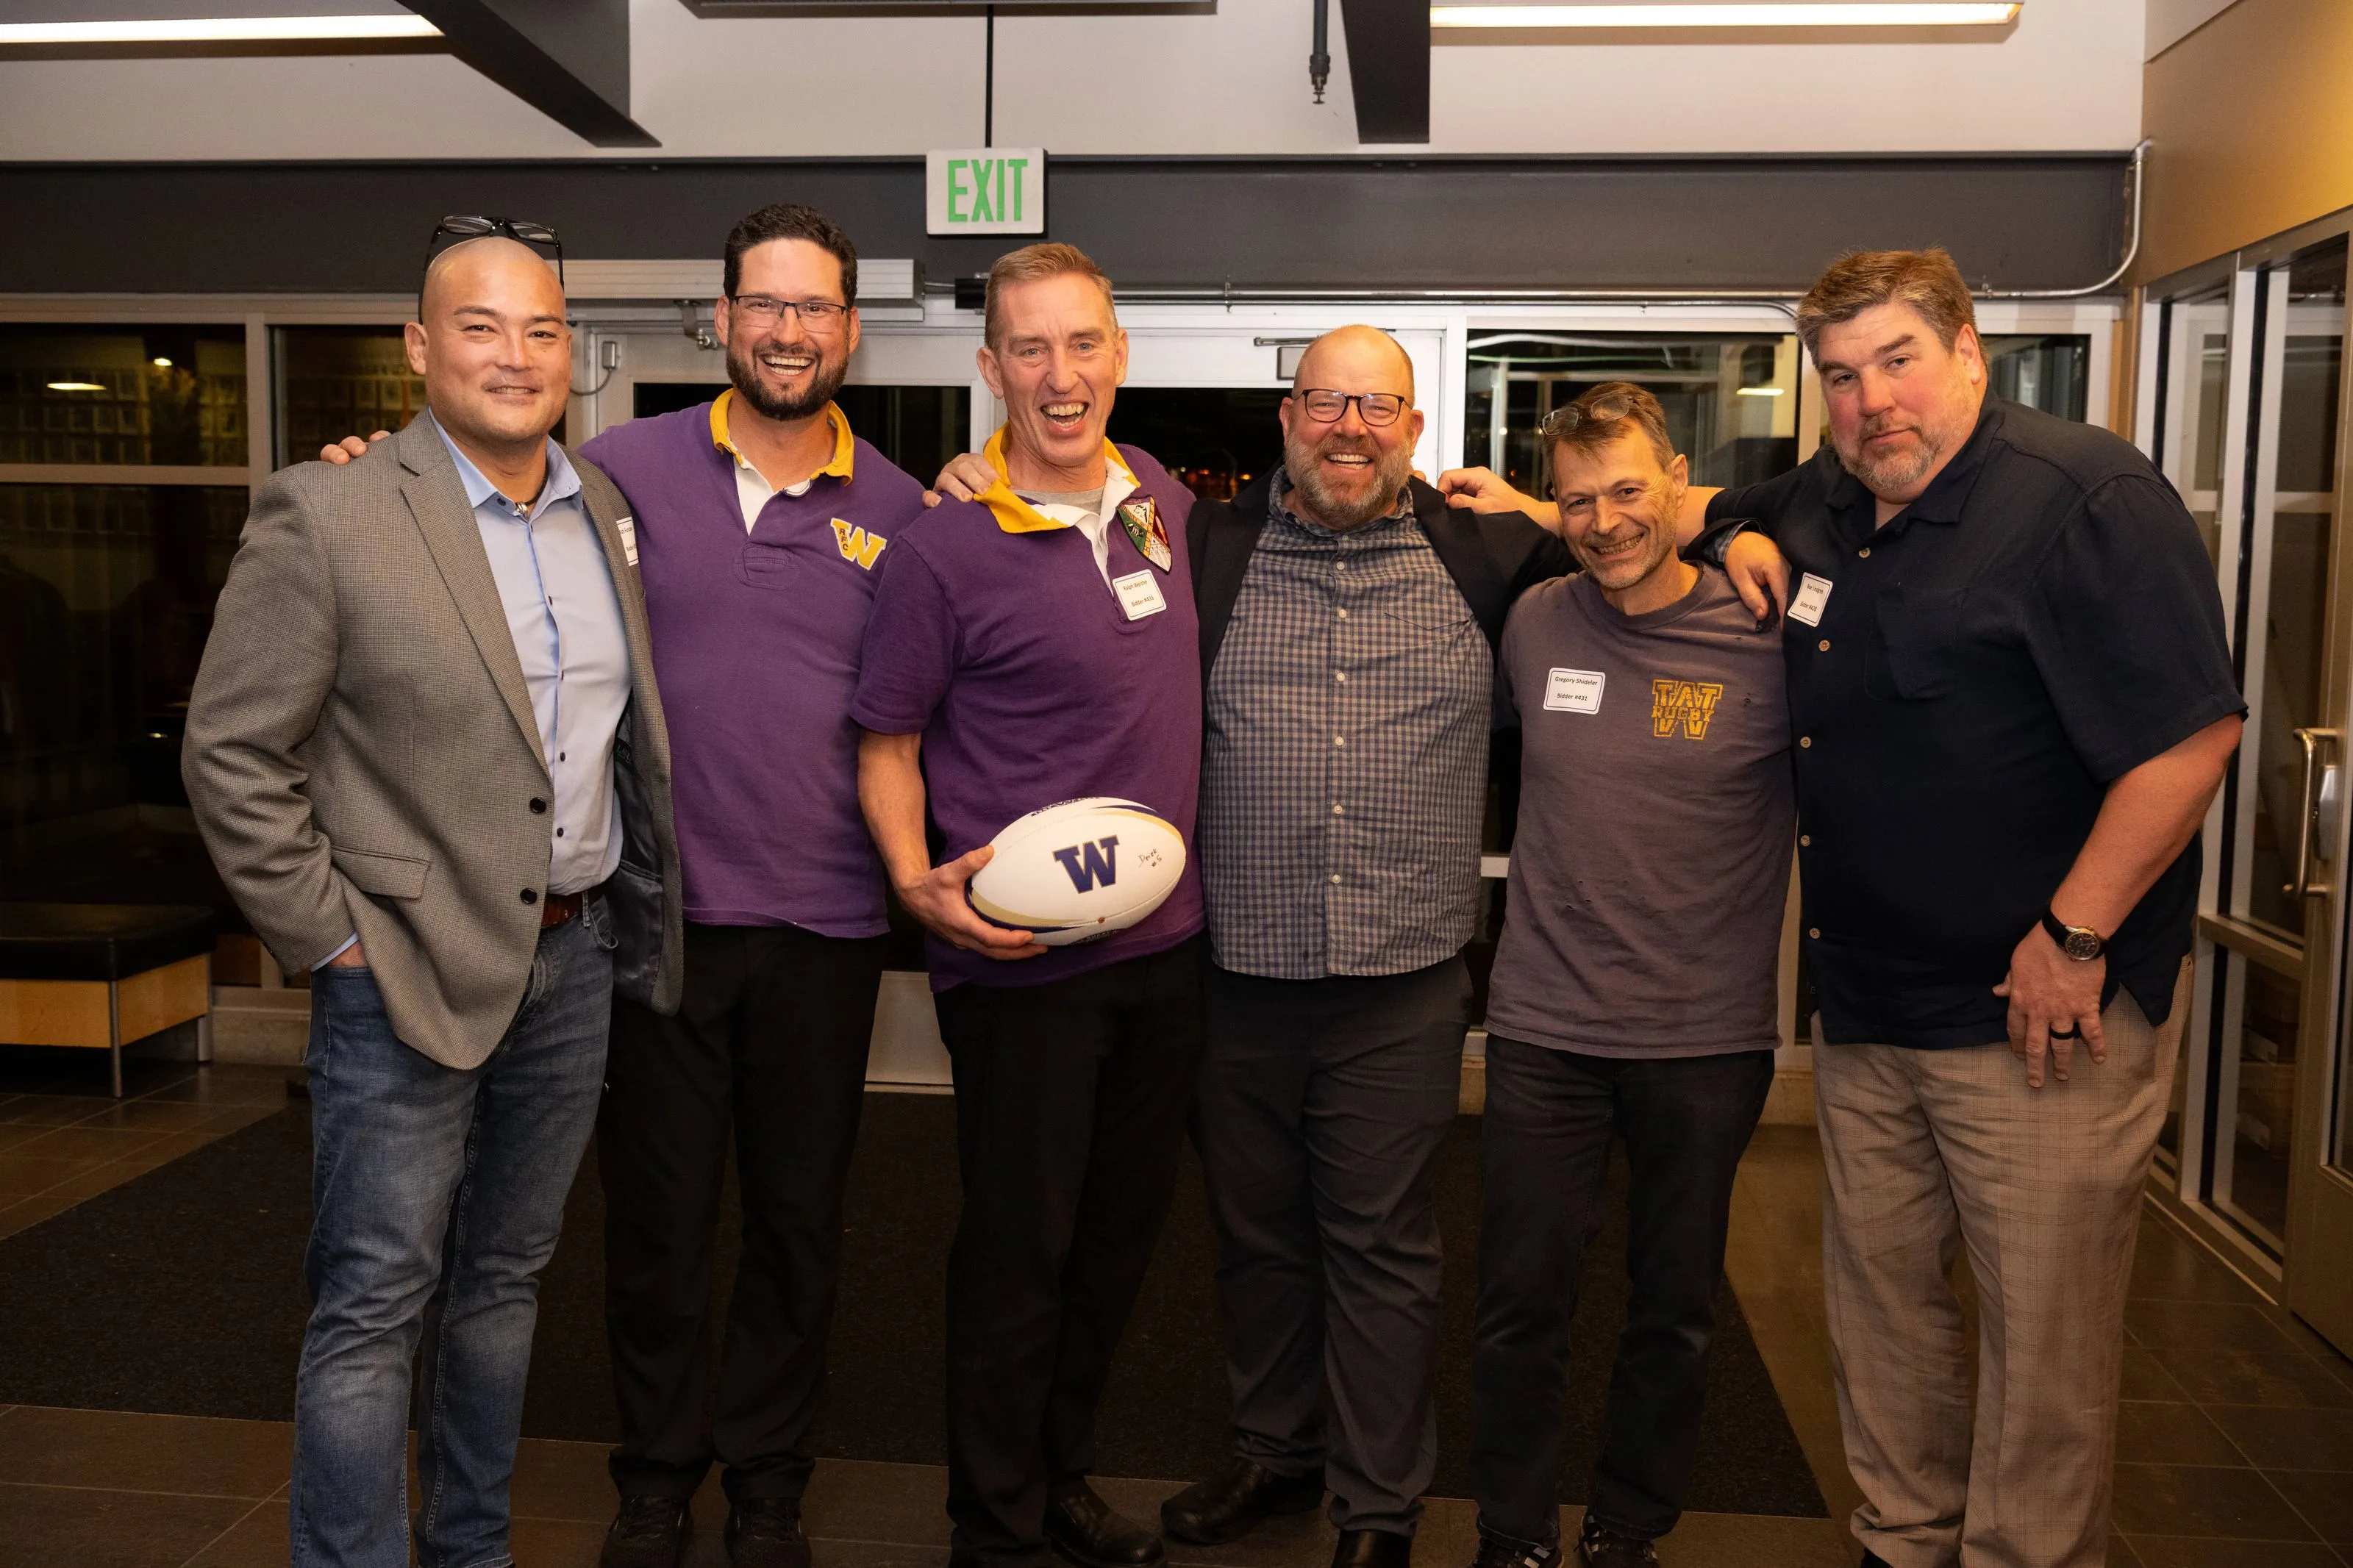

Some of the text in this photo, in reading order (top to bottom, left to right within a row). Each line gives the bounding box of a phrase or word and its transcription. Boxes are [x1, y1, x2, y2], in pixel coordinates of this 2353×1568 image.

[948, 159, 1028, 223] EXIT
[830, 518, 888, 570] W
[839, 529, 849, 551] RFC
[1131, 598, 1144, 606] Bidder
[1651, 706, 1715, 722] RUGBY
[1052, 834, 1120, 895] W
